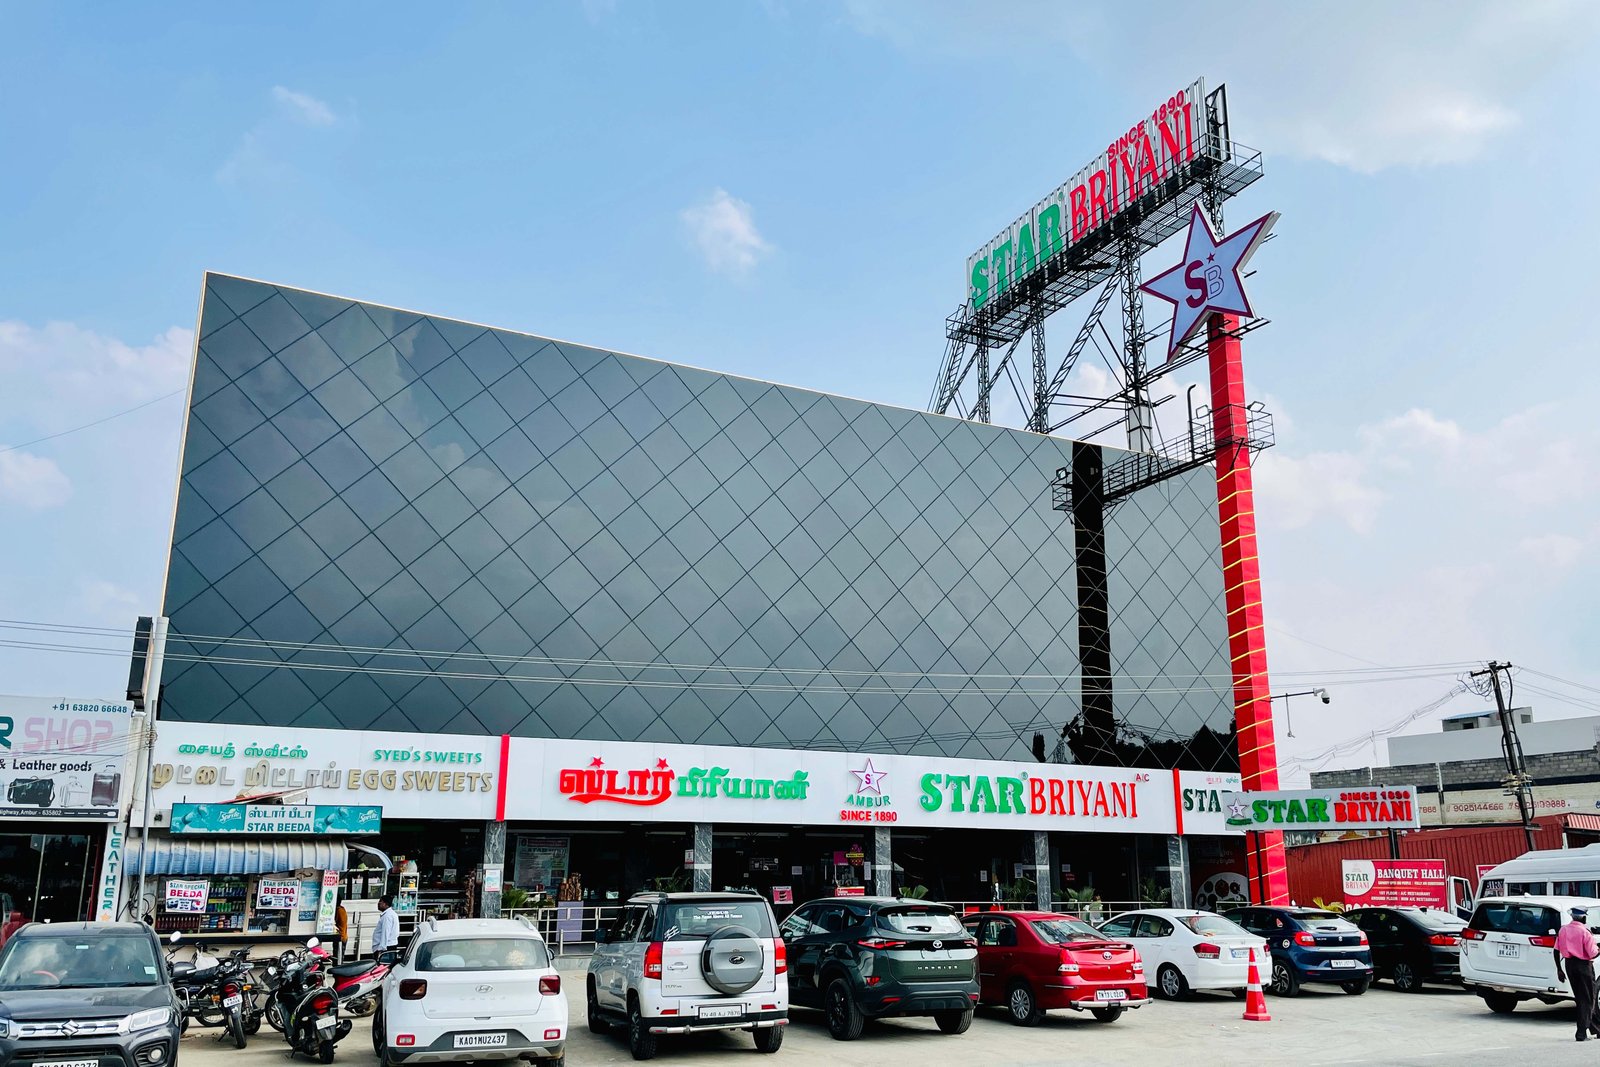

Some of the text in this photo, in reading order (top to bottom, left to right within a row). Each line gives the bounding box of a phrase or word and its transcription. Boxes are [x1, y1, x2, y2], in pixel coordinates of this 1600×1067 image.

[1107, 89, 1185, 160] SINCE 1890
[971, 102, 1195, 310] STAR BRIYANI
[52, 703, 128, 713] +91 63820 66648
[23, 716, 114, 753] SHOP
[425, 751, 483, 764] SWEETS
[12, 759, 57, 771] Leather
[59, 760, 92, 773] goods
[347, 768, 493, 793] EGG SWEETS
[846, 793, 891, 808] AMBUR
[918, 772, 1138, 818] STAR BRIYANI
[1183, 788, 1232, 813] STA
[1340, 790, 1411, 802] SINCE 1890
[840, 809, 898, 822] SINCE 1890
[1252, 798, 1413, 824] STAR BRIYANI
[247, 822, 311, 832] STAR BEEDA
[102, 825, 122, 910] LEATHER
[1377, 868, 1444, 879] BANQUET HALL
[1345, 873, 1369, 882] STAR
[170, 889, 203, 898] BEEDA
[264, 887, 295, 895] BEEDA
